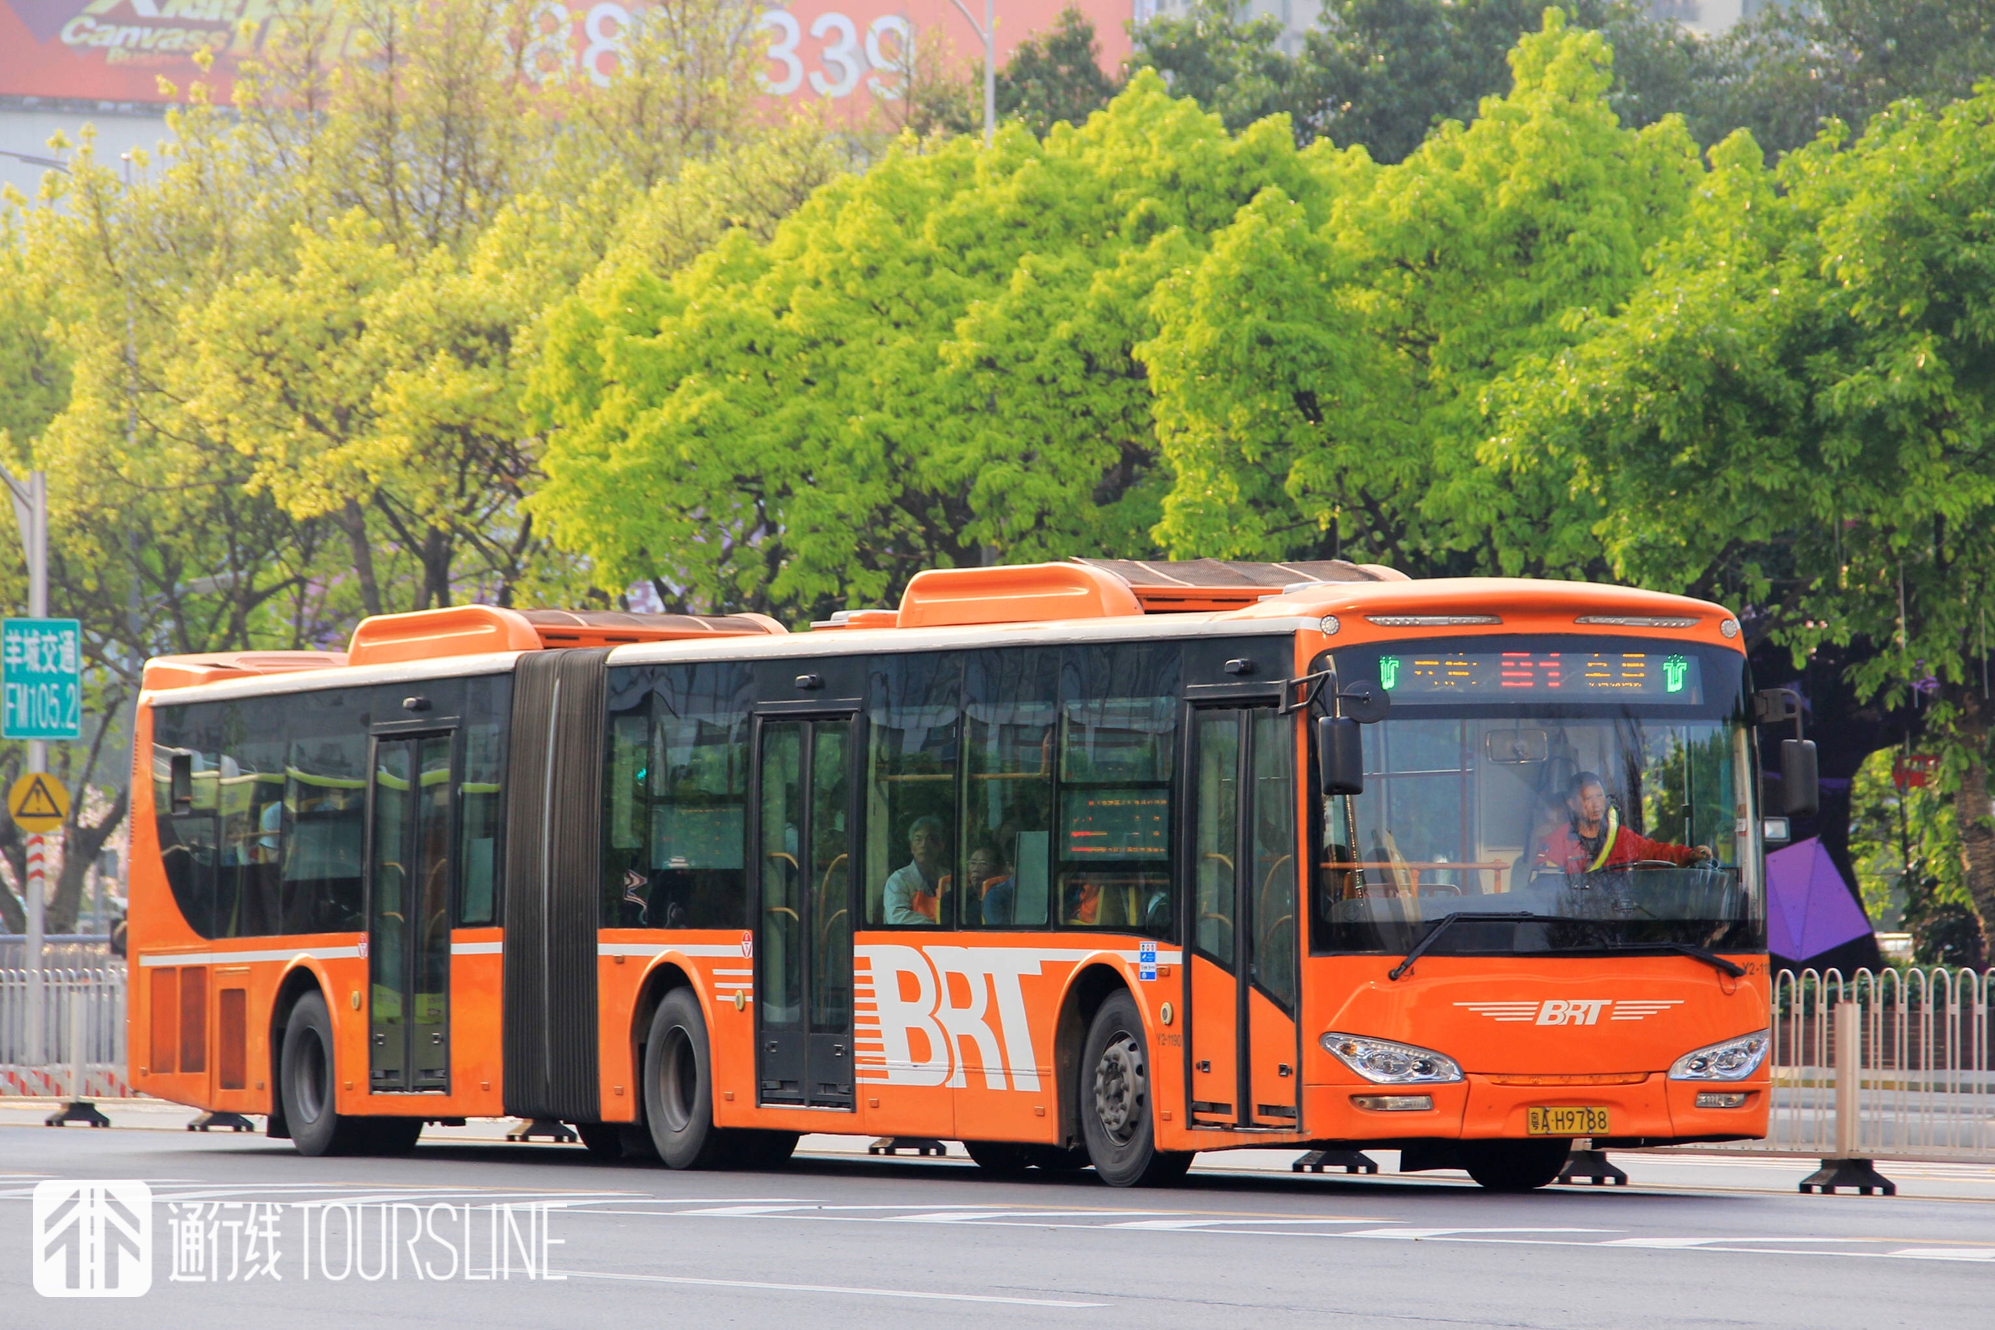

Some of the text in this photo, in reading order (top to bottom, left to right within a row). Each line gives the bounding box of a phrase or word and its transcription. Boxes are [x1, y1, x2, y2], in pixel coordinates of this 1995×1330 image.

[60, 16, 229, 50] Canvass
[5, 629, 75, 673] 羊城交通
[5, 683, 76, 728] FM105.2
[868, 945, 1043, 1091] BRT
[1536, 1000, 1612, 1025] BRT
